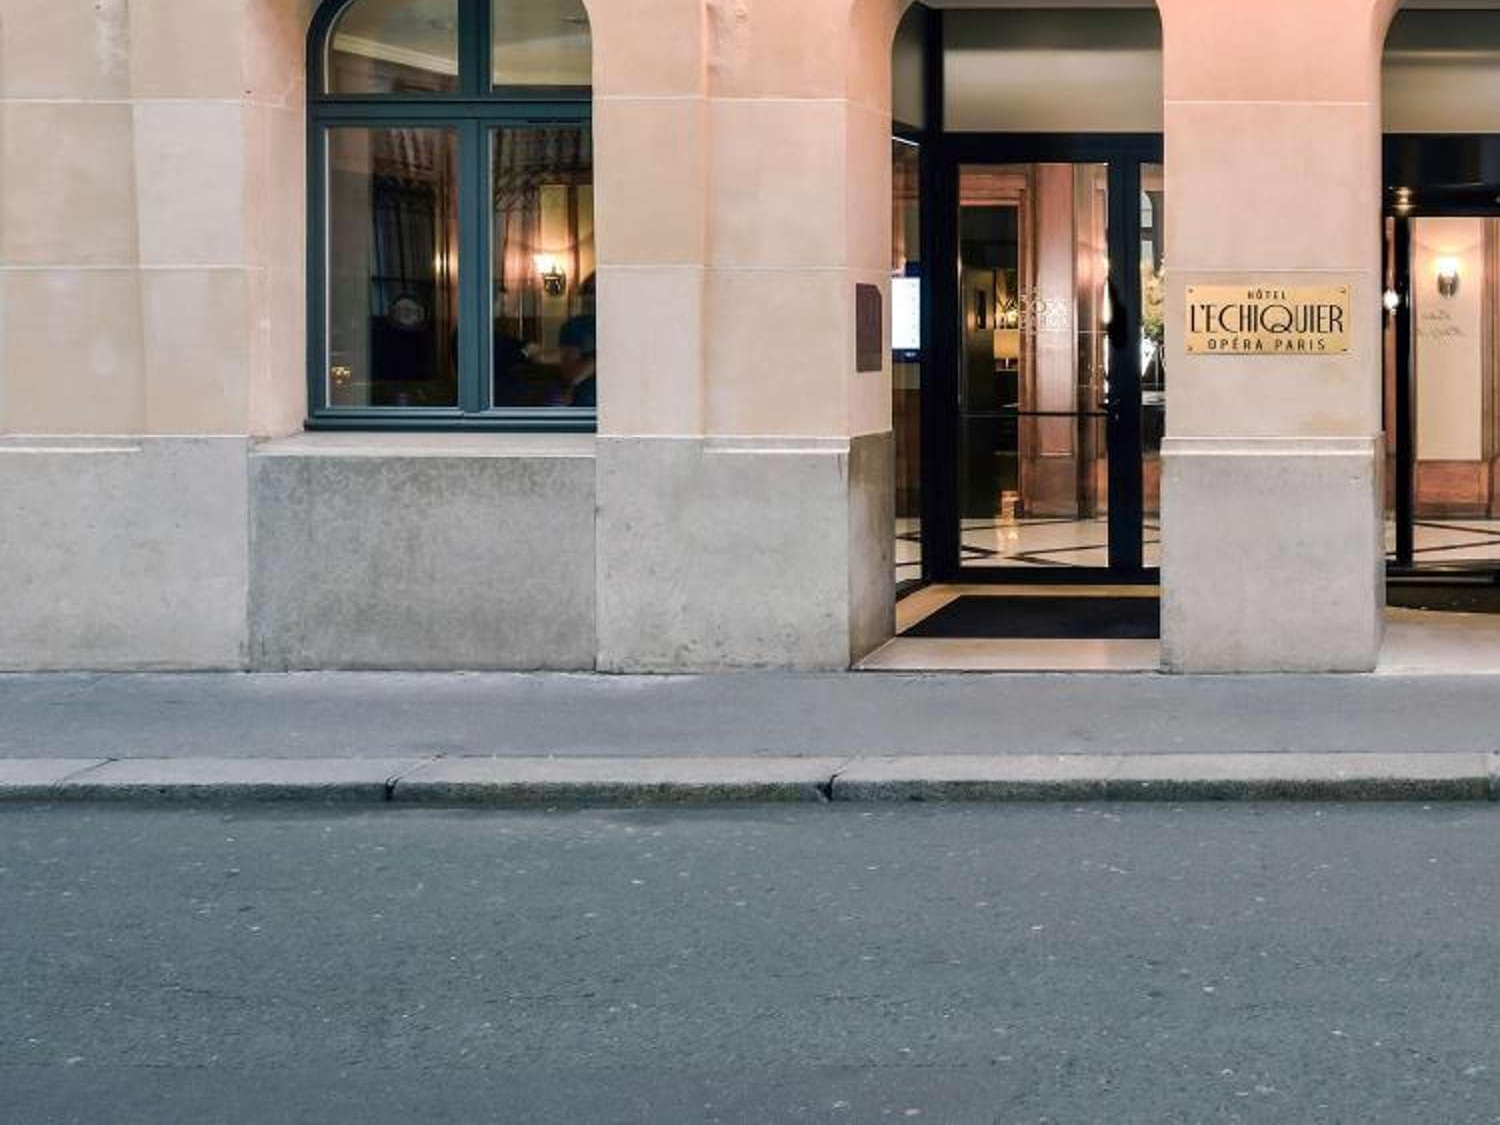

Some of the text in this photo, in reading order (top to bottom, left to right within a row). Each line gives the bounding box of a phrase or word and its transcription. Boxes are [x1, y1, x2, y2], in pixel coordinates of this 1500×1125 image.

[1247, 288, 1286, 300] HÔTEL
[1190, 304, 1344, 334] L'ECHIQUIER
[1207, 335, 1326, 351] OPÉRA PARIS
